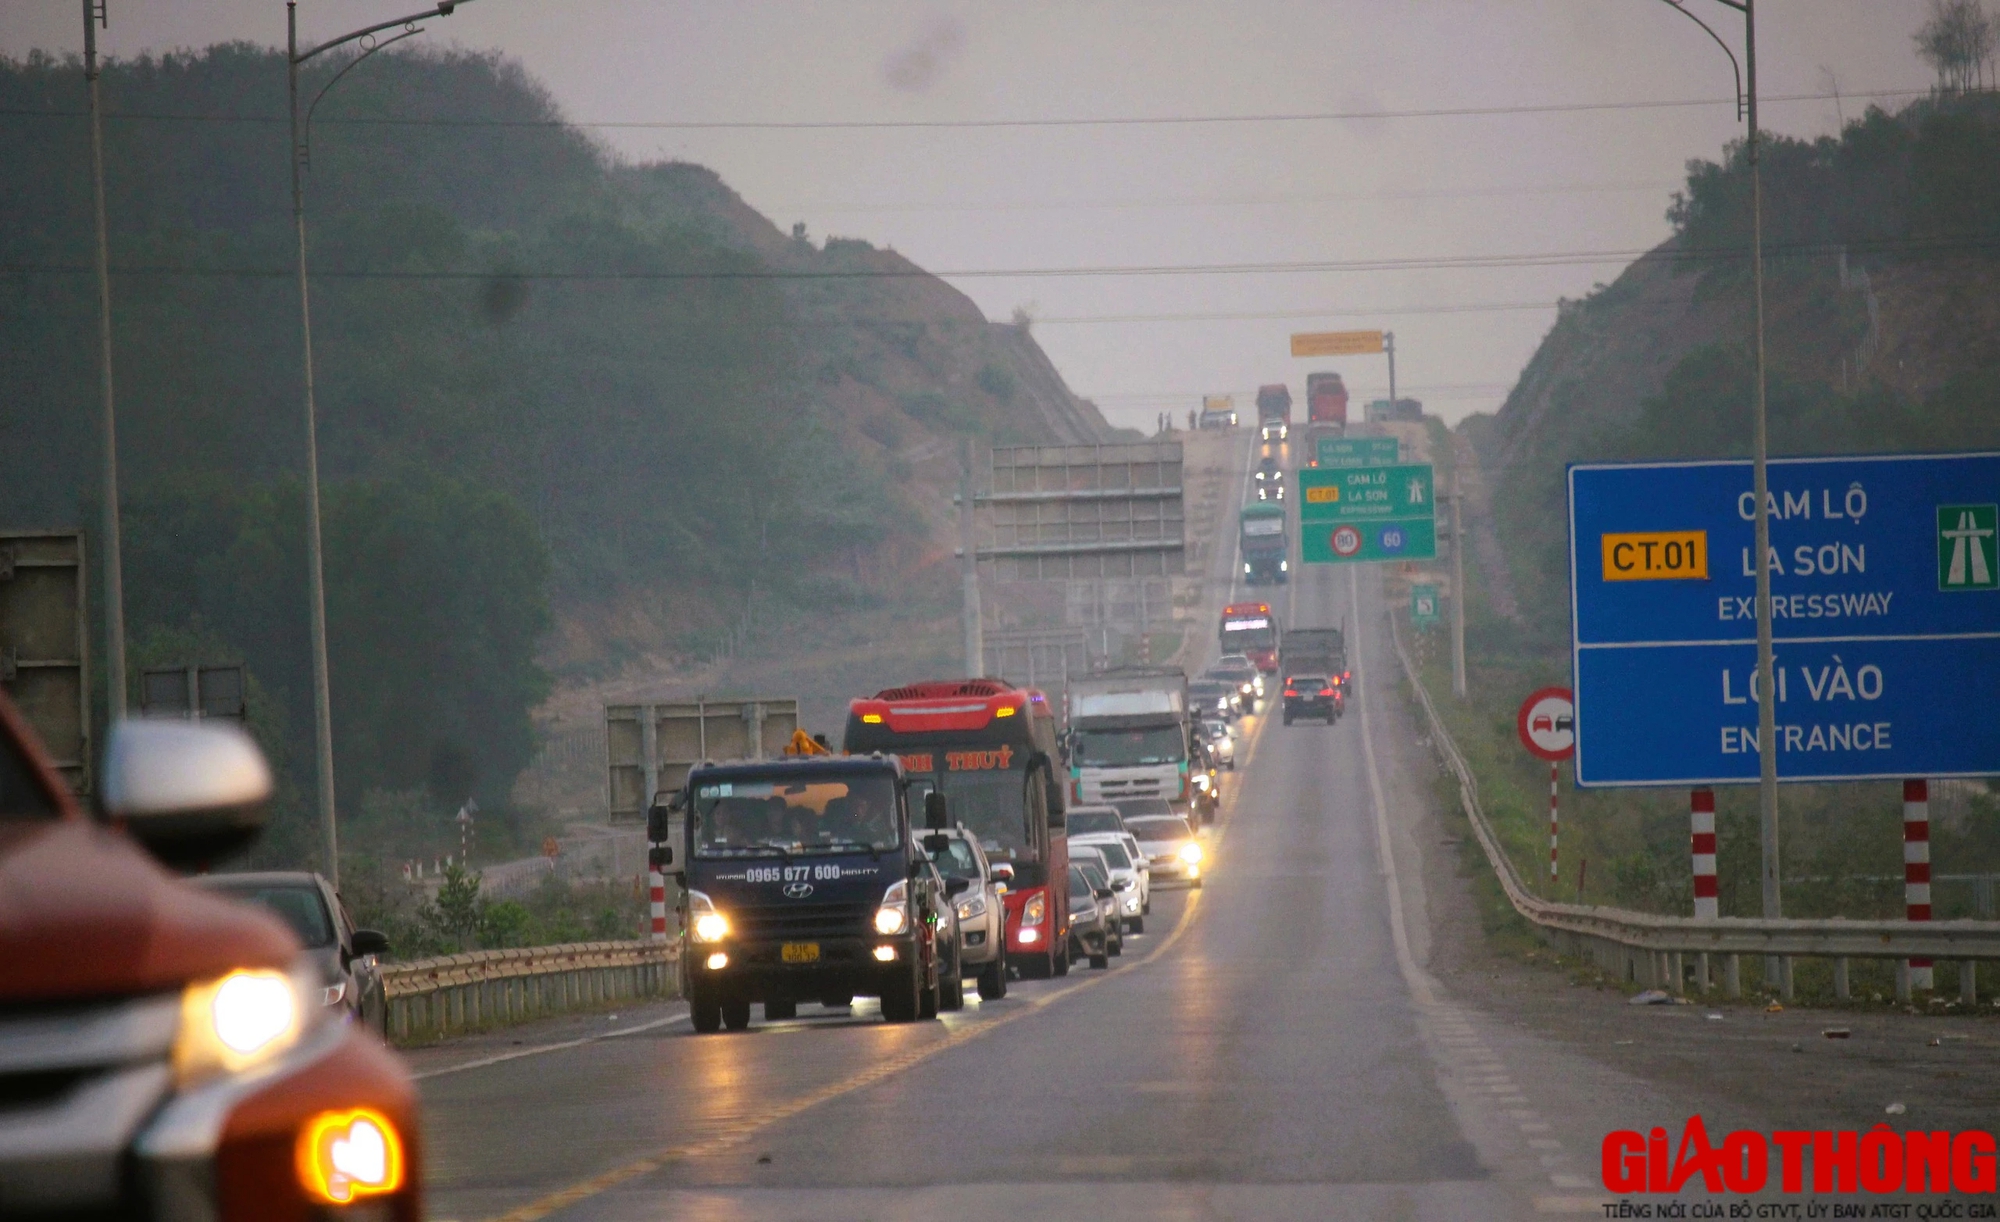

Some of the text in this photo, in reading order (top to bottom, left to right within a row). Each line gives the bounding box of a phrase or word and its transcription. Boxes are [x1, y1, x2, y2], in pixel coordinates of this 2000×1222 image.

[1347, 473, 1371, 485] CAM
[1348, 491, 1363, 502] LA
[1738, 481, 1868, 525] CAM LỘ
[1337, 532, 1400, 548] 80 60
[1613, 540, 1695, 571] CT.01
[1794, 541, 1866, 577] SƠN
[1801, 654, 1883, 702] VÀO
[746, 864, 840, 883] 0965 677 600
